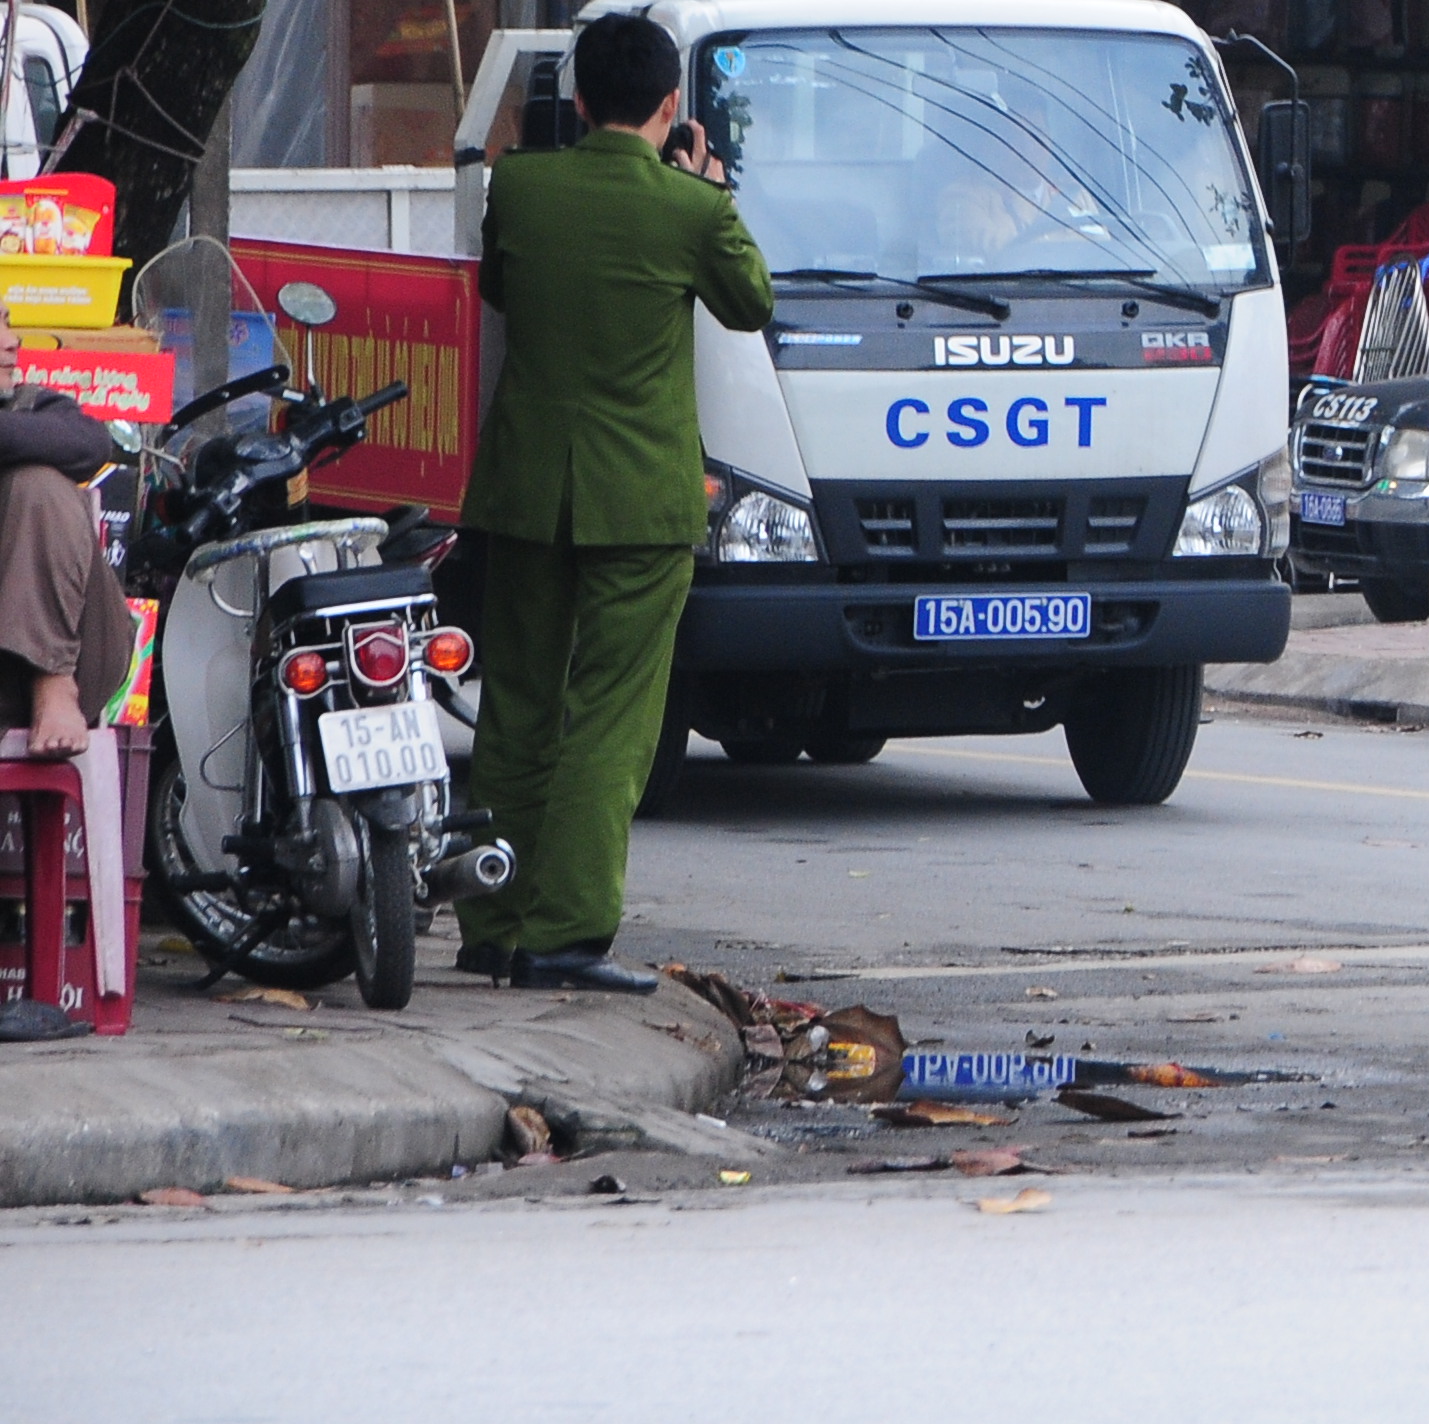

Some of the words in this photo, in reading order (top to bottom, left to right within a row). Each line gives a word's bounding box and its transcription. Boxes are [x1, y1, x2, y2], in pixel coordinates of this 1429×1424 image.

[934, 335, 1075, 366] ISUZU
[885, 396, 1108, 449] CSGT
[1313, 393, 1379, 422] CS113
[925, 597, 1084, 634] 15A-005.90
[335, 742, 437, 784] 010.00
